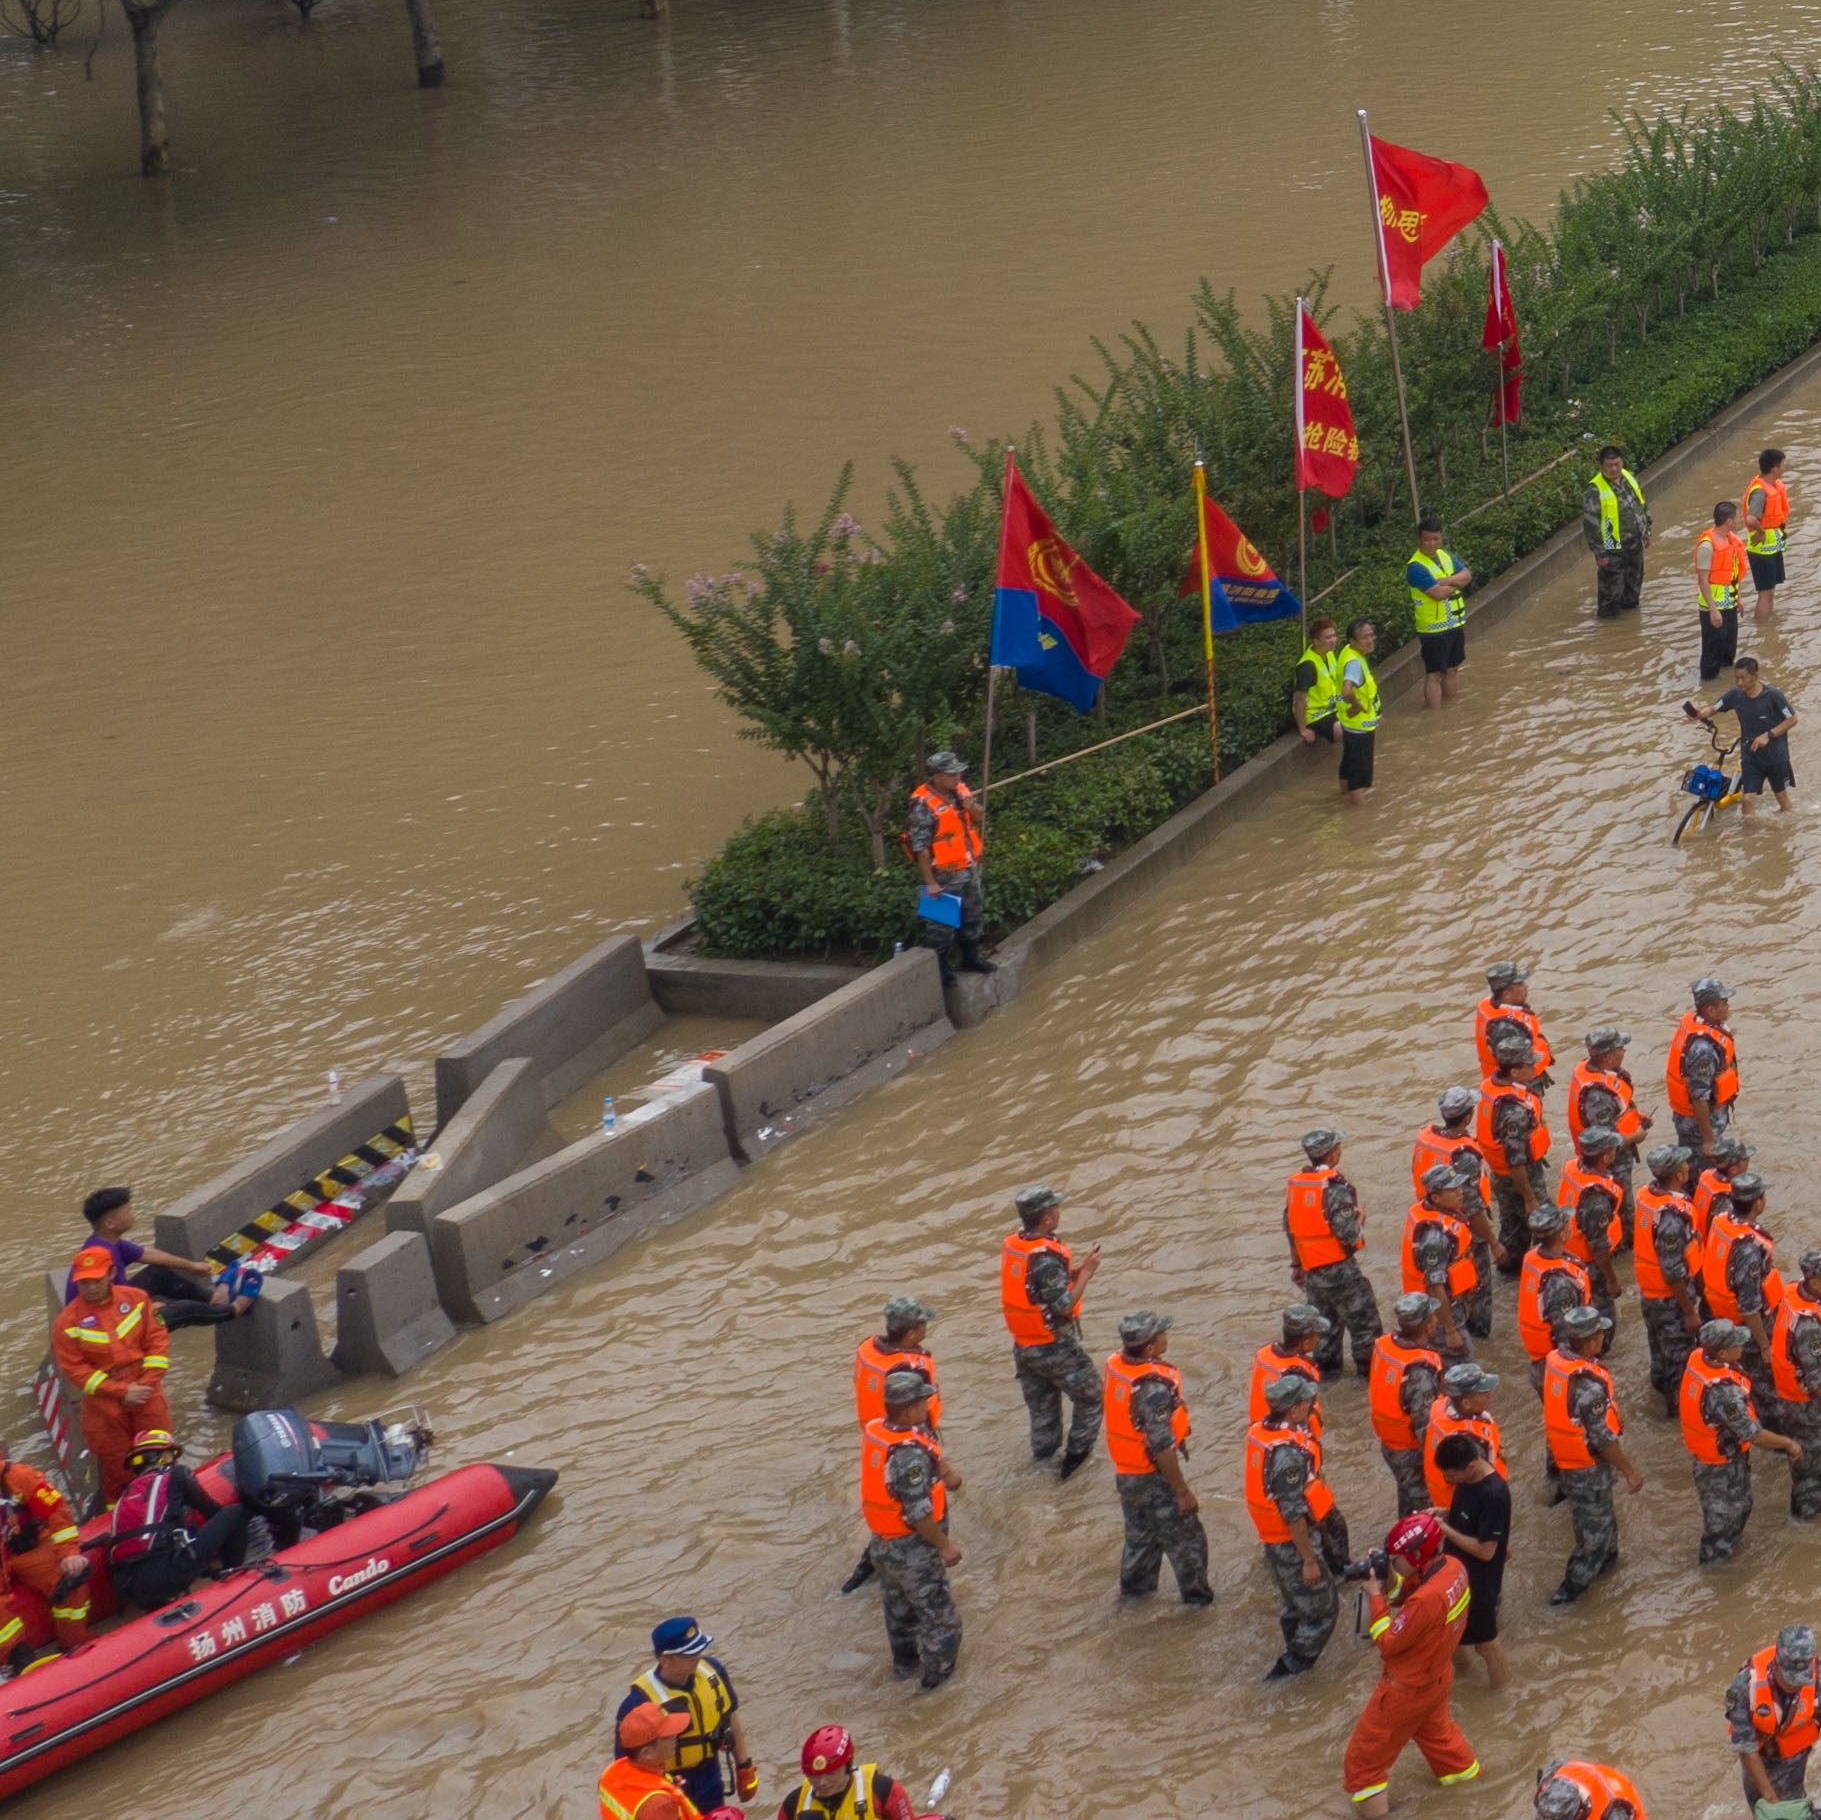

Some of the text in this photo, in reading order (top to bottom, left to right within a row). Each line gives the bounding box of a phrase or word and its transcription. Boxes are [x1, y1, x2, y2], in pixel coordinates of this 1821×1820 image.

[328, 1557, 390, 1597] Cando
[189, 1587, 307, 1661] 扬州消防
